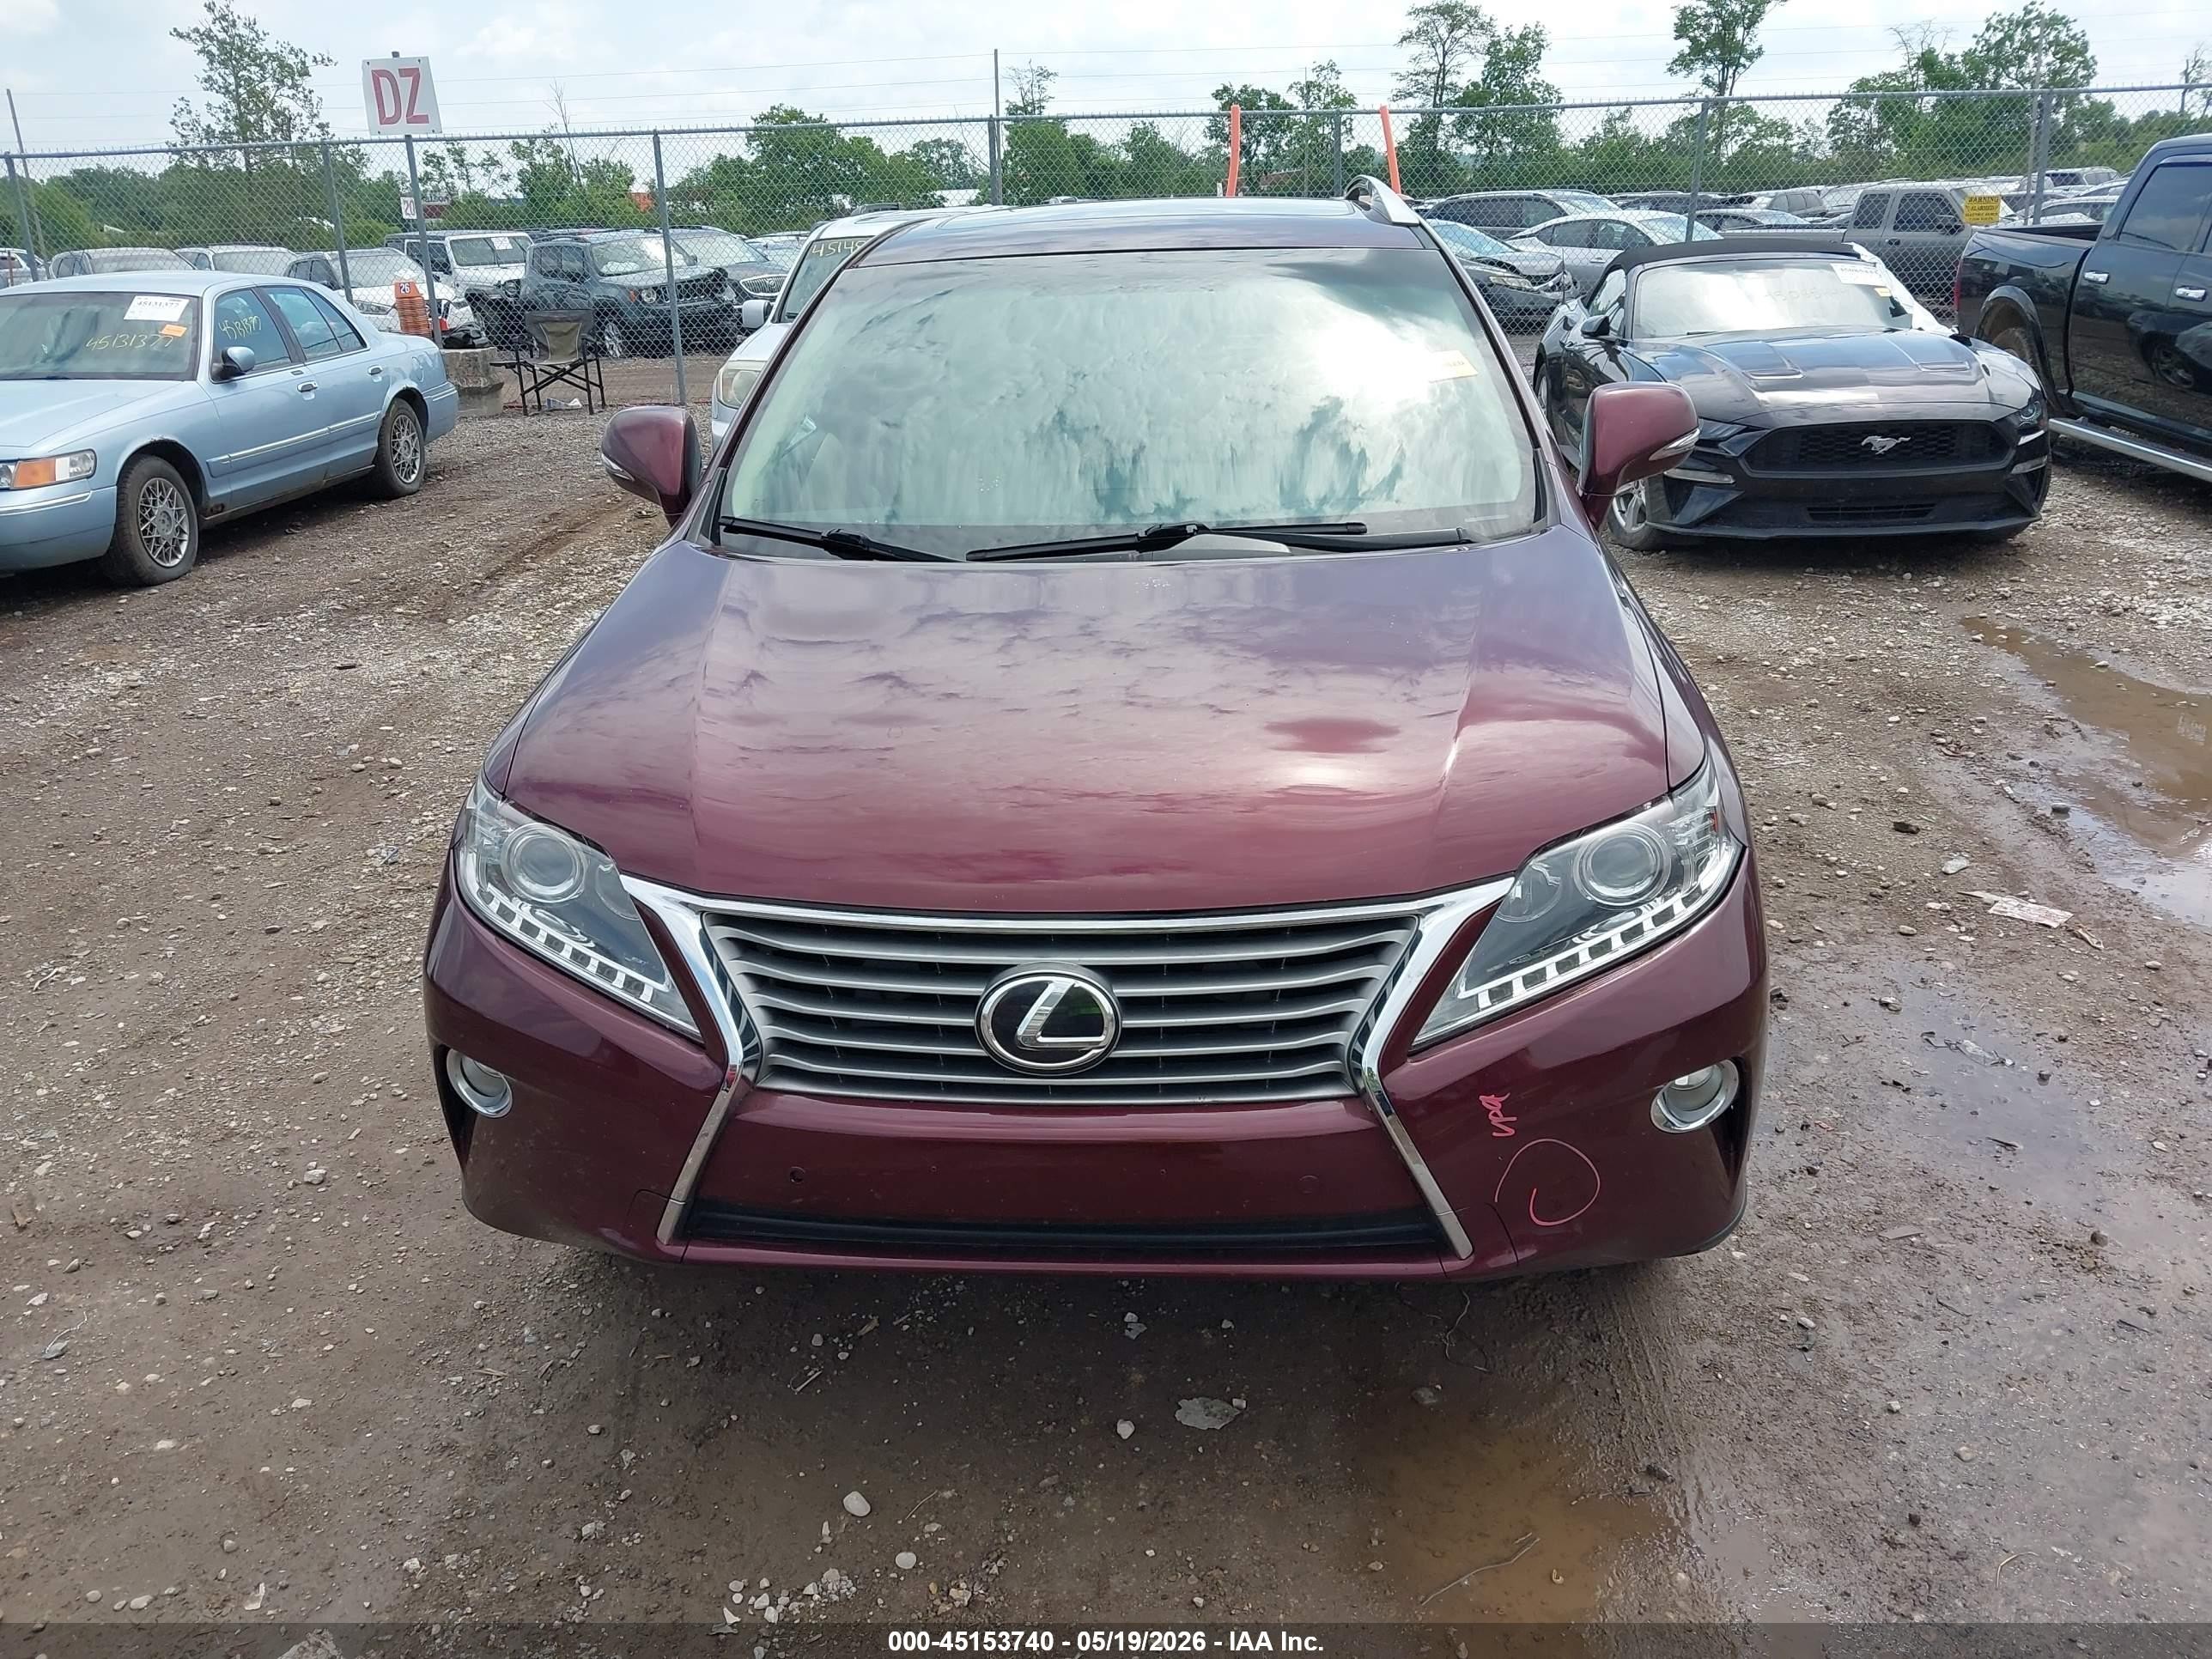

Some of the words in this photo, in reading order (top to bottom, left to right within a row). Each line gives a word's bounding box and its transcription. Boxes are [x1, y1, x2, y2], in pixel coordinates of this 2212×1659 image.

[371, 68, 429, 125] DZ
[404, 199, 416, 216] 20
[399, 283, 410, 294] 26
